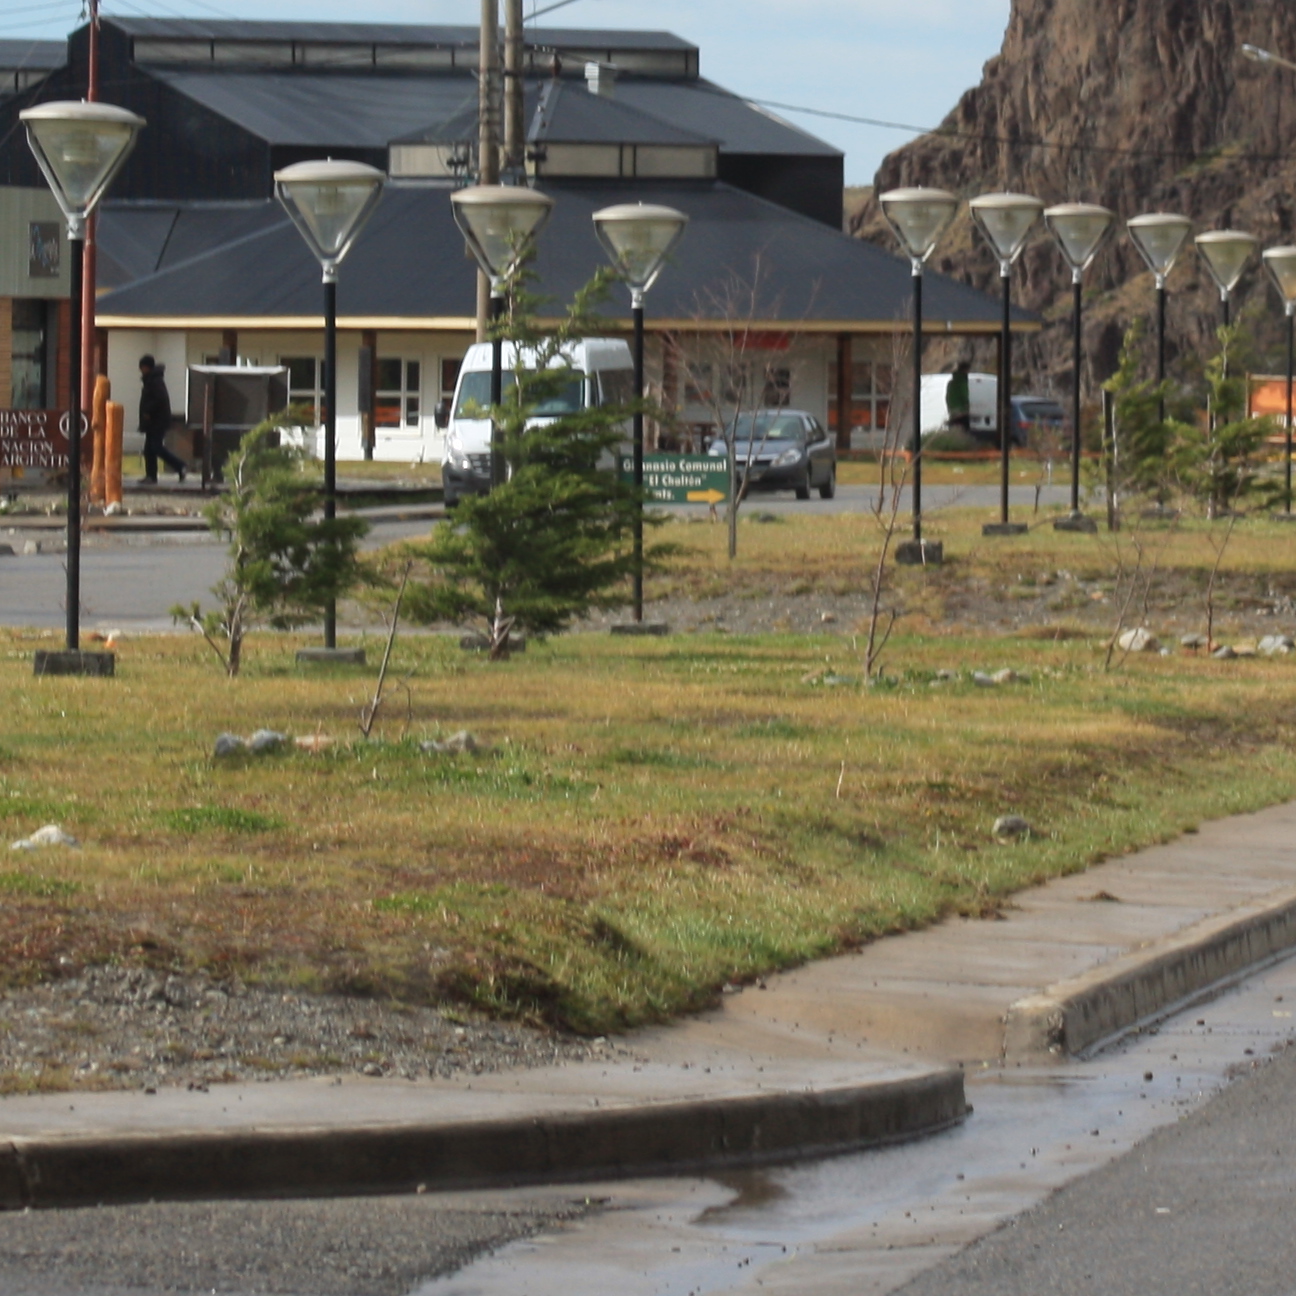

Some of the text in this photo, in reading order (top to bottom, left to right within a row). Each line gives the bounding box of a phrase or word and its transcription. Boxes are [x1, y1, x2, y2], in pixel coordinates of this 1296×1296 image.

[0, 411, 47, 425] BANCO
[0, 425, 46, 438] DE LA
[2, 454, 70, 467] ARGENTIN
[679, 459, 727, 472] Comunal
